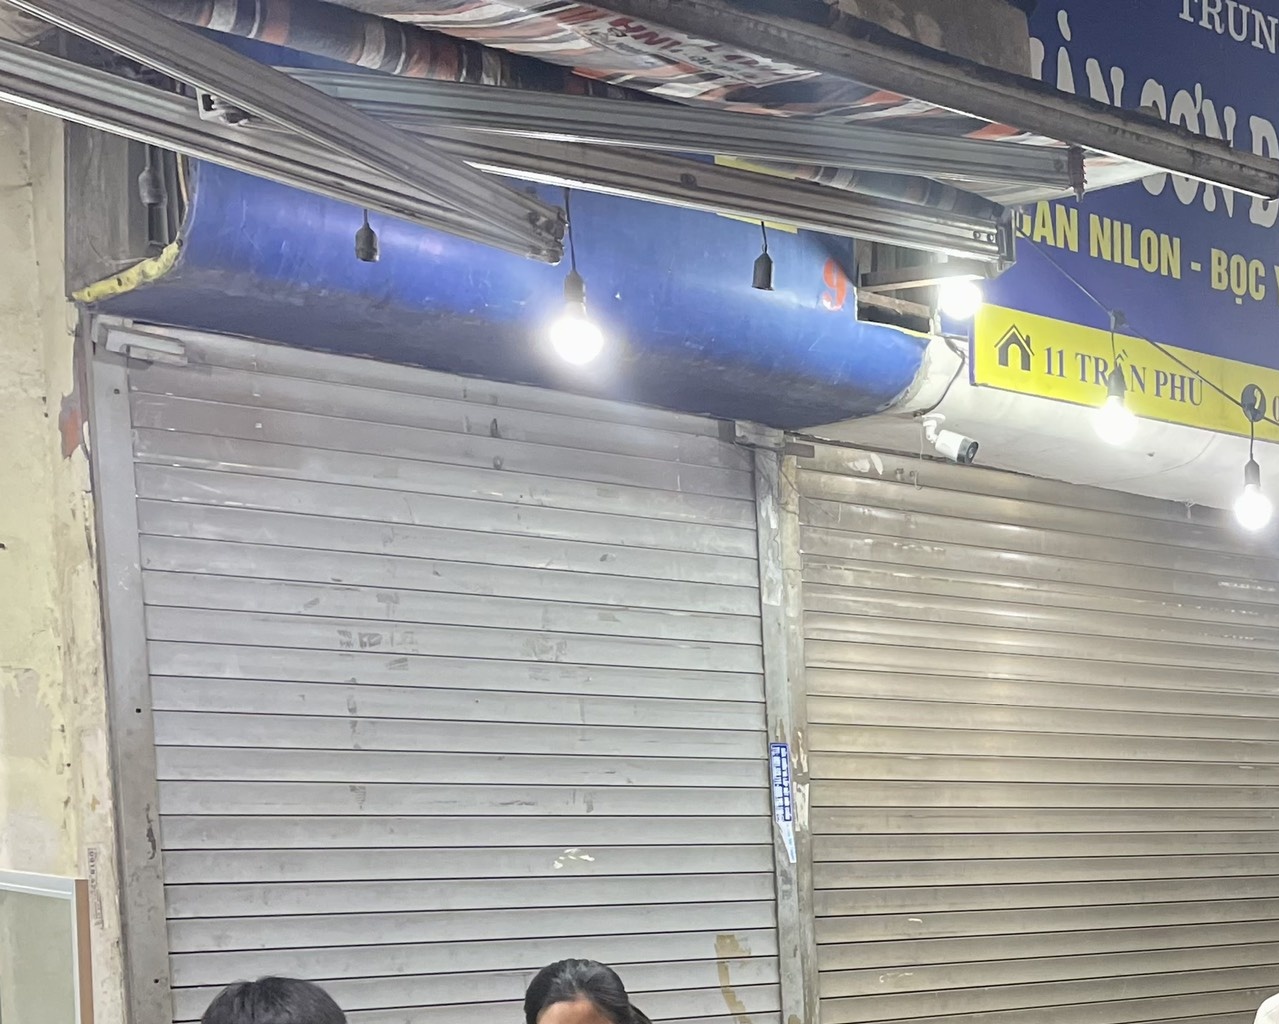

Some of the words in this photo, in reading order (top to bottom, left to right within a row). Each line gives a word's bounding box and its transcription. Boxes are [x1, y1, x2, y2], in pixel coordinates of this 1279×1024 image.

[823, 257, 847, 311] 9
[1090, 213, 1181, 279] NILON
[1211, 248, 1265, 304] BỌC
[1044, 347, 1067, 378] 11
